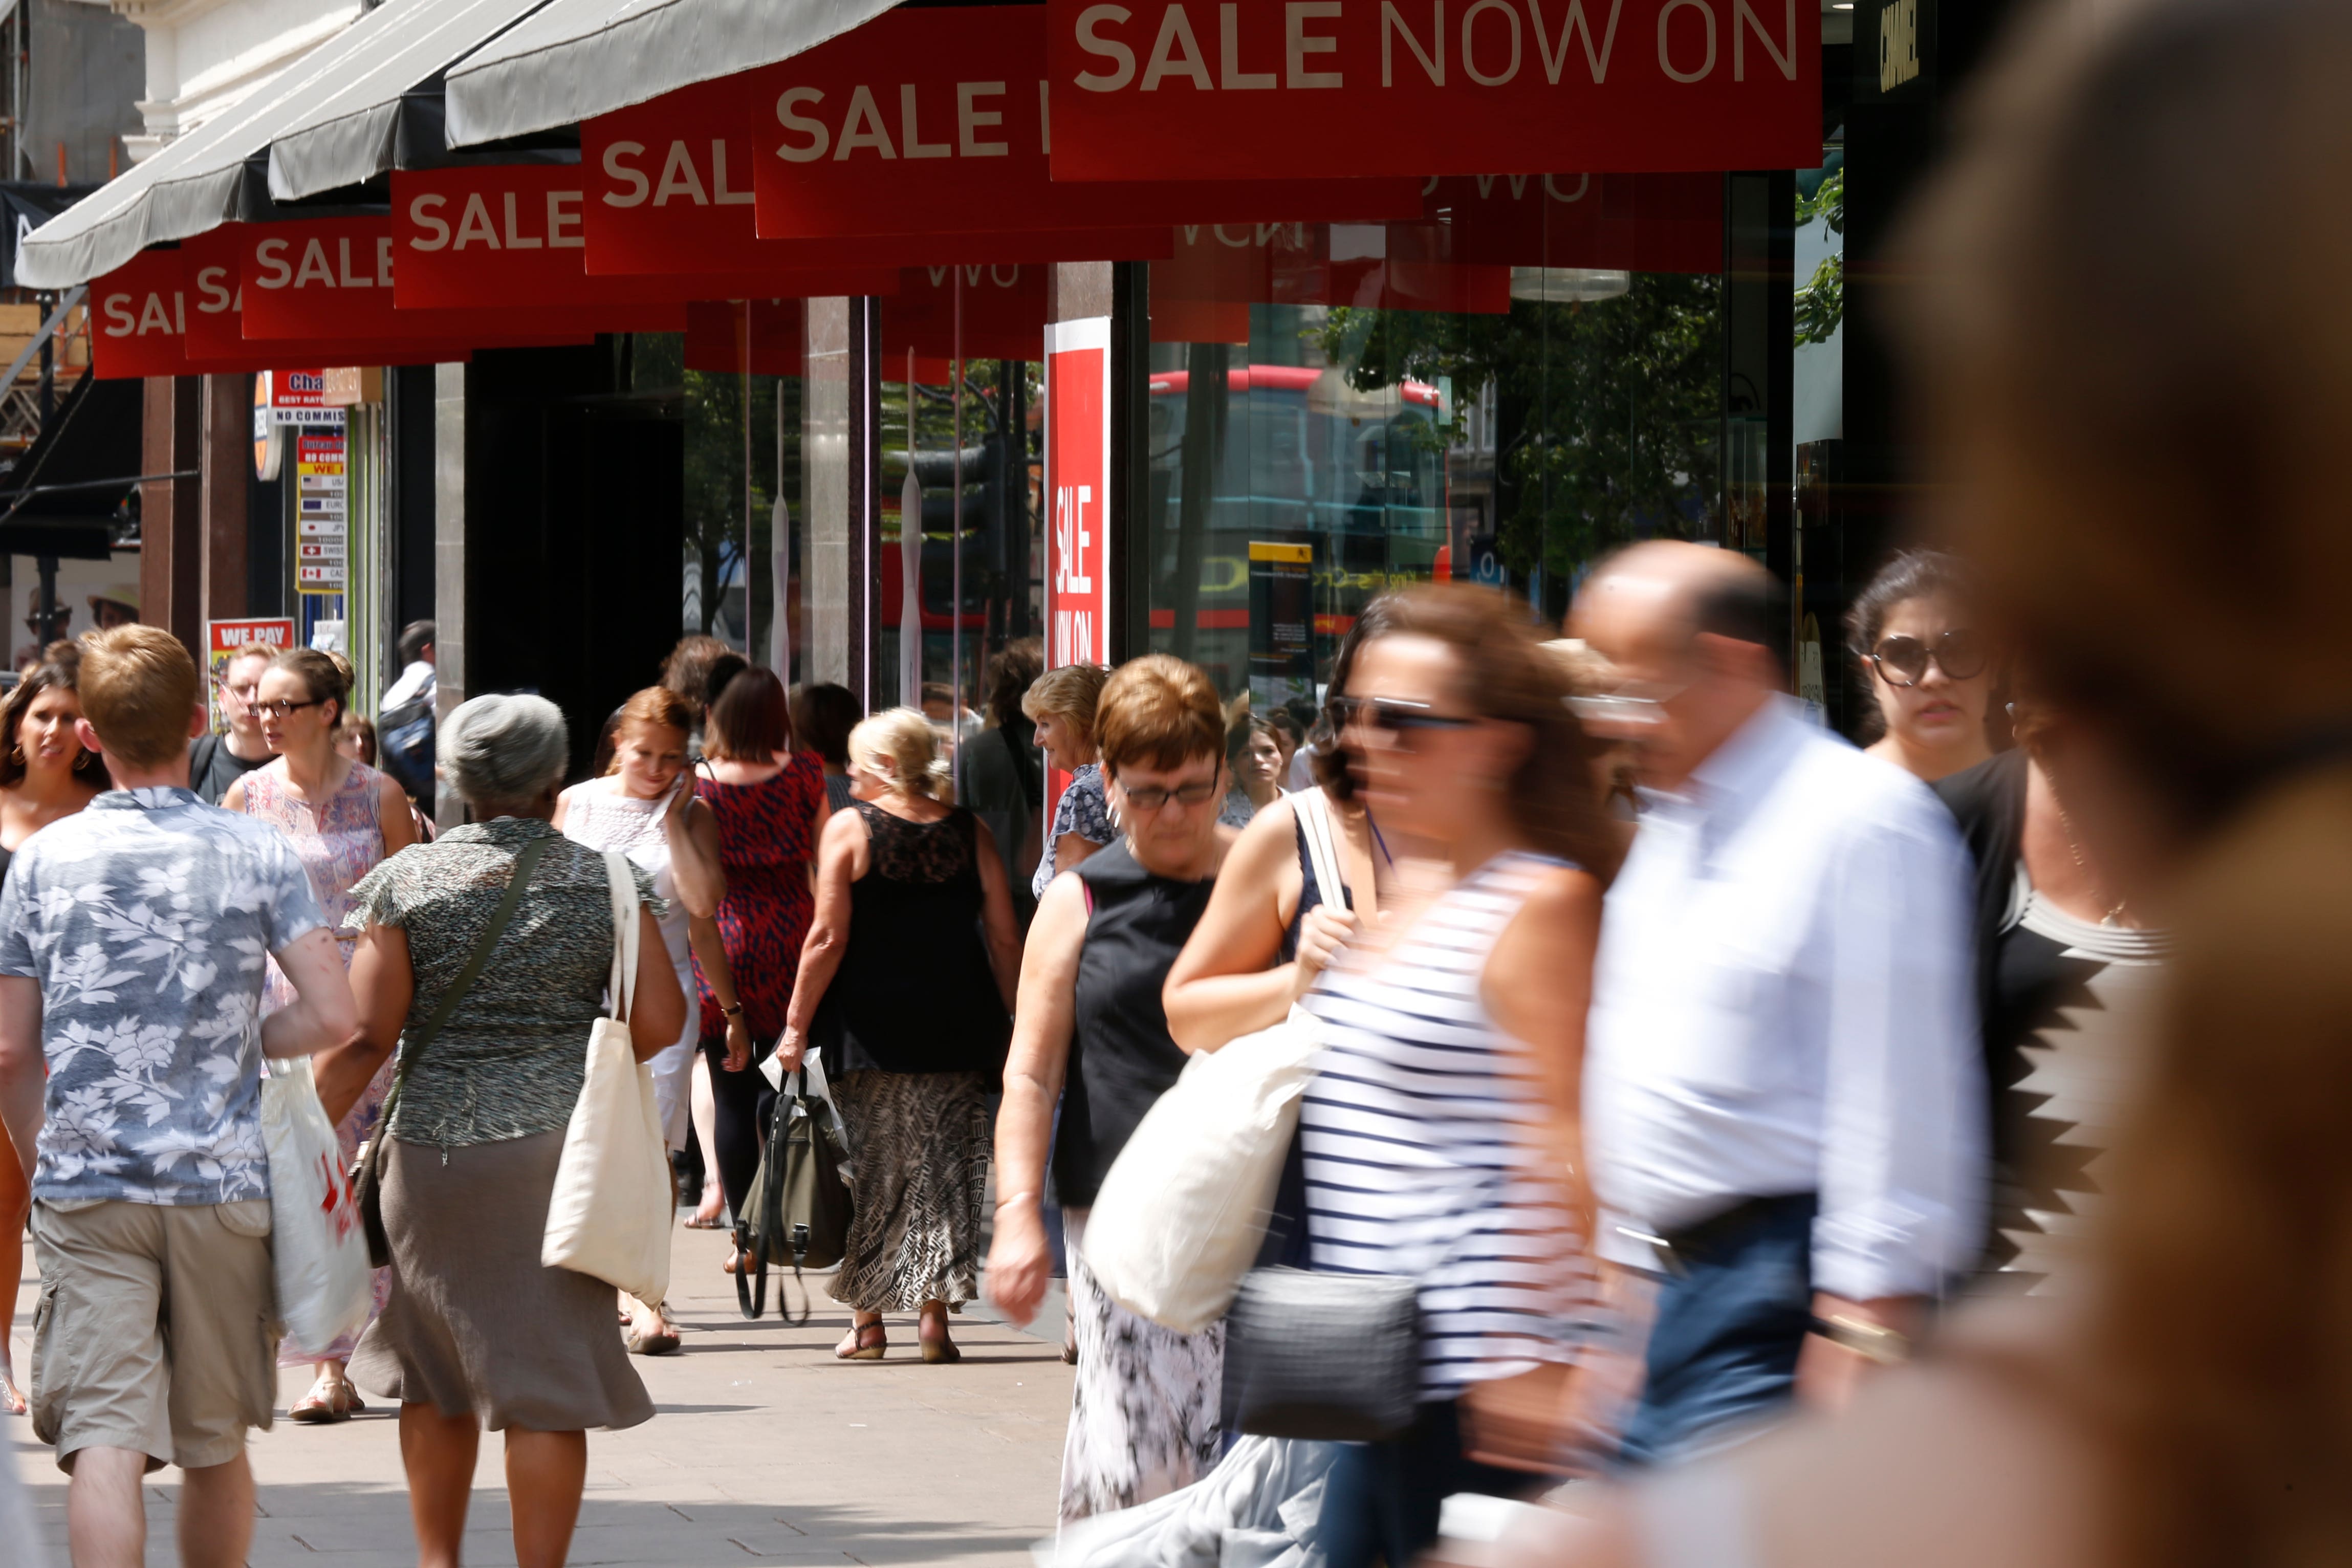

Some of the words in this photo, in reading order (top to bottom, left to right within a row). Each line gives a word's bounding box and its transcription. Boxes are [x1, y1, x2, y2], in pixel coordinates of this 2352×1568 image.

[1073, 1, 1343, 93] SALE
[1382, 0, 1623, 87] NOW
[1657, 0, 1796, 82] ON
[776, 81, 1009, 163] SALE
[409, 190, 585, 252] SALE
[197, 266, 242, 313] S
[277, 410, 291, 421] NO
[278, 395, 300, 404] BEST
[305, 453, 316, 462] NO
[314, 465, 334, 474] WE
[1055, 485, 1091, 594] SALE
[221, 628, 249, 646] WE
[254, 626, 285, 644] PAY
[1074, 609, 1092, 666] ON
